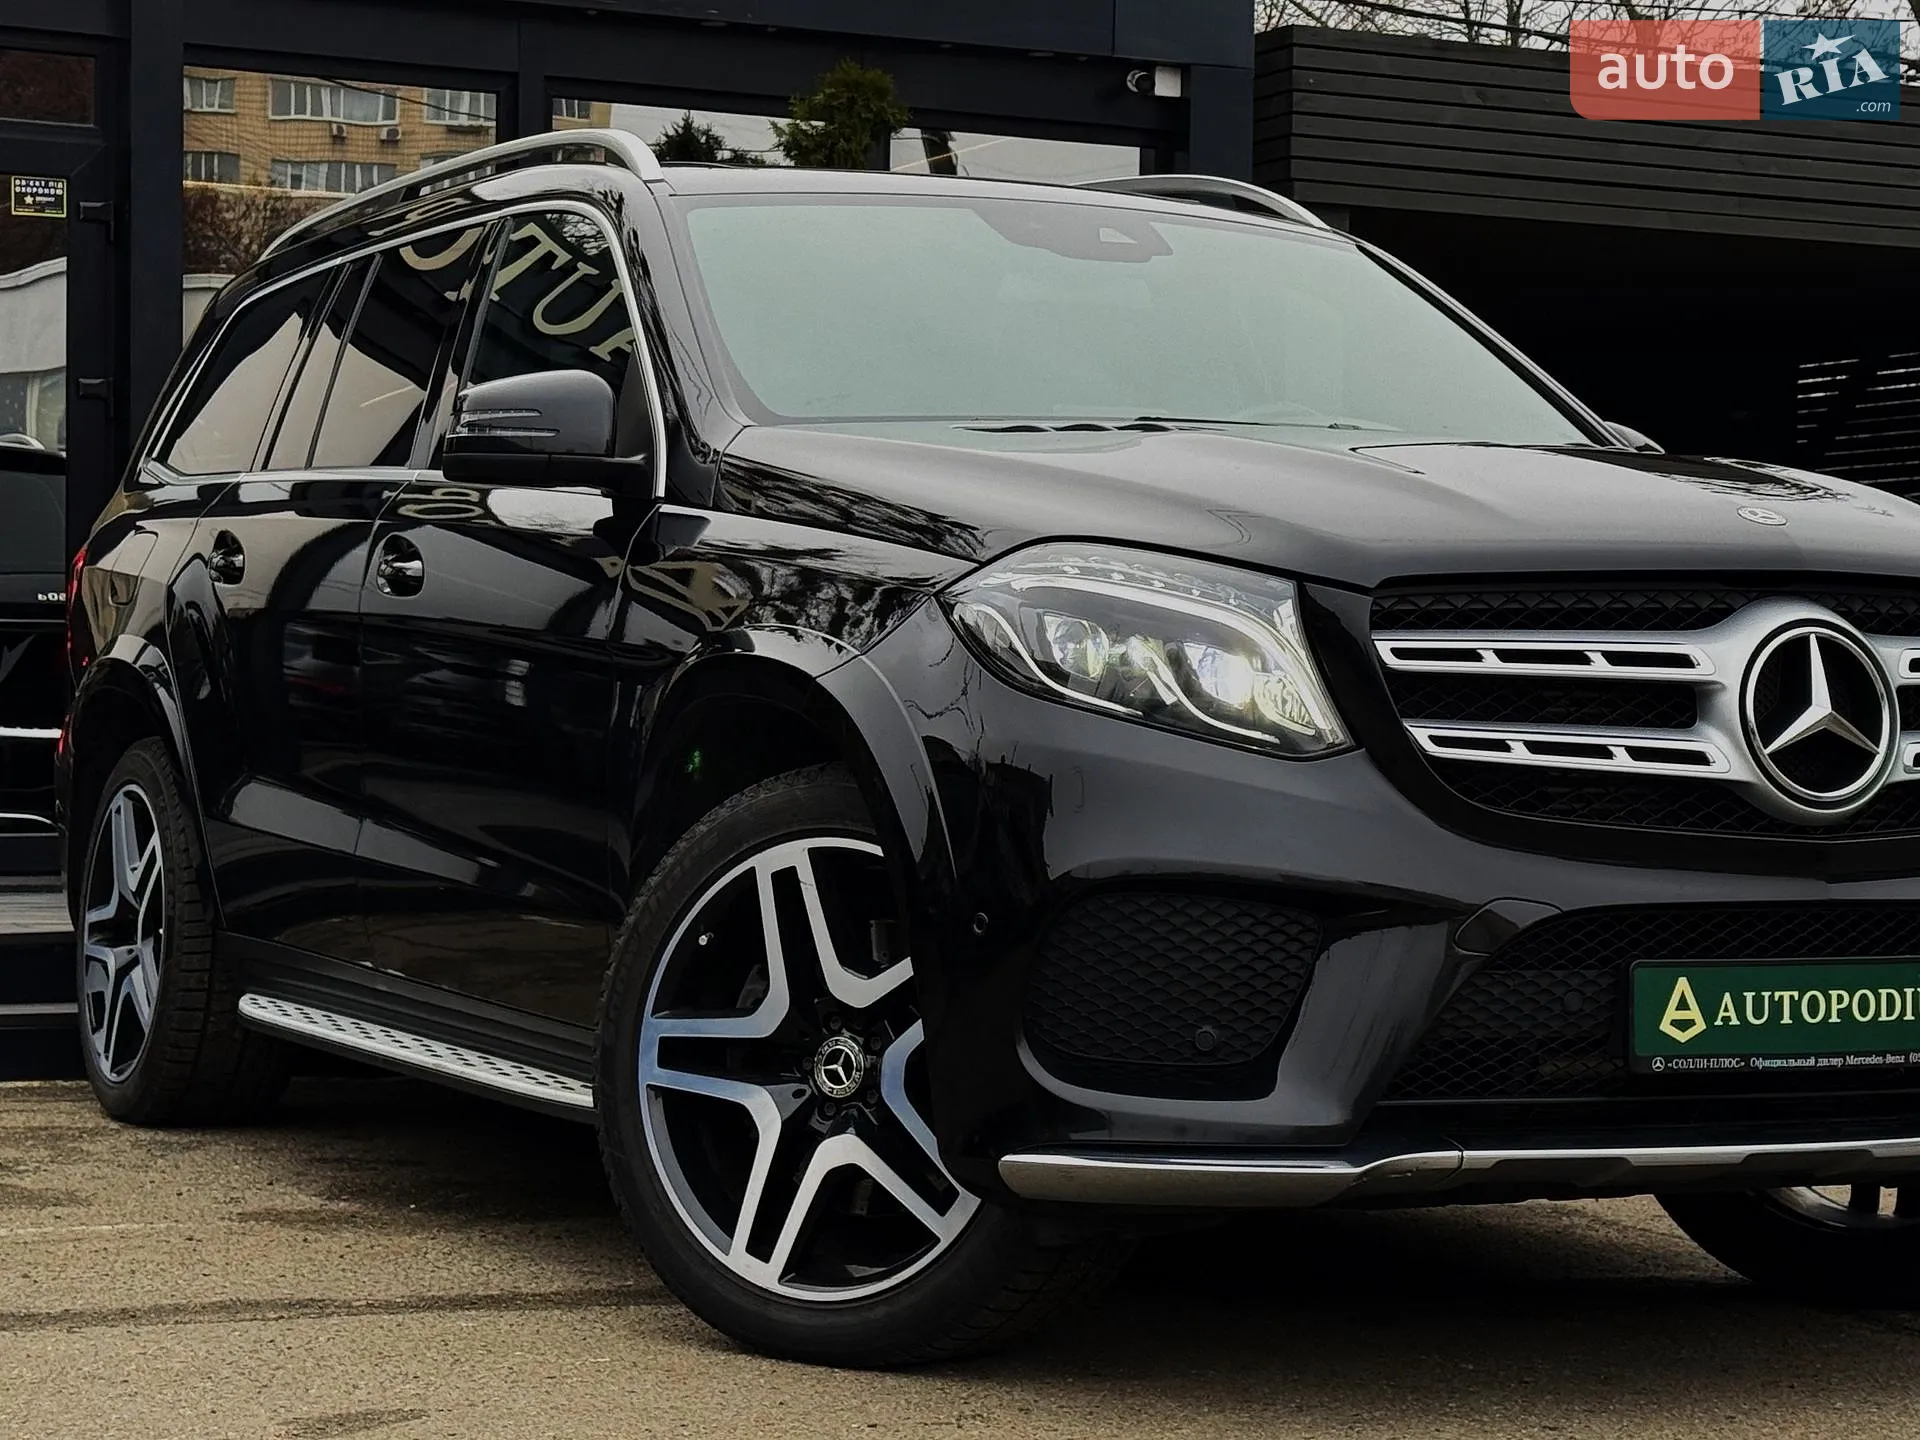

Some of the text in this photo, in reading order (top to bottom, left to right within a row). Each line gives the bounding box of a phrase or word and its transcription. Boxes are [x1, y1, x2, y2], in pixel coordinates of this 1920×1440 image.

[1714, 988, 1920, 1026] AUTOPODI
[1817, 1056, 1844, 1068] дилер
[1845, 1053, 1905, 1066] Mercedes-Benz
